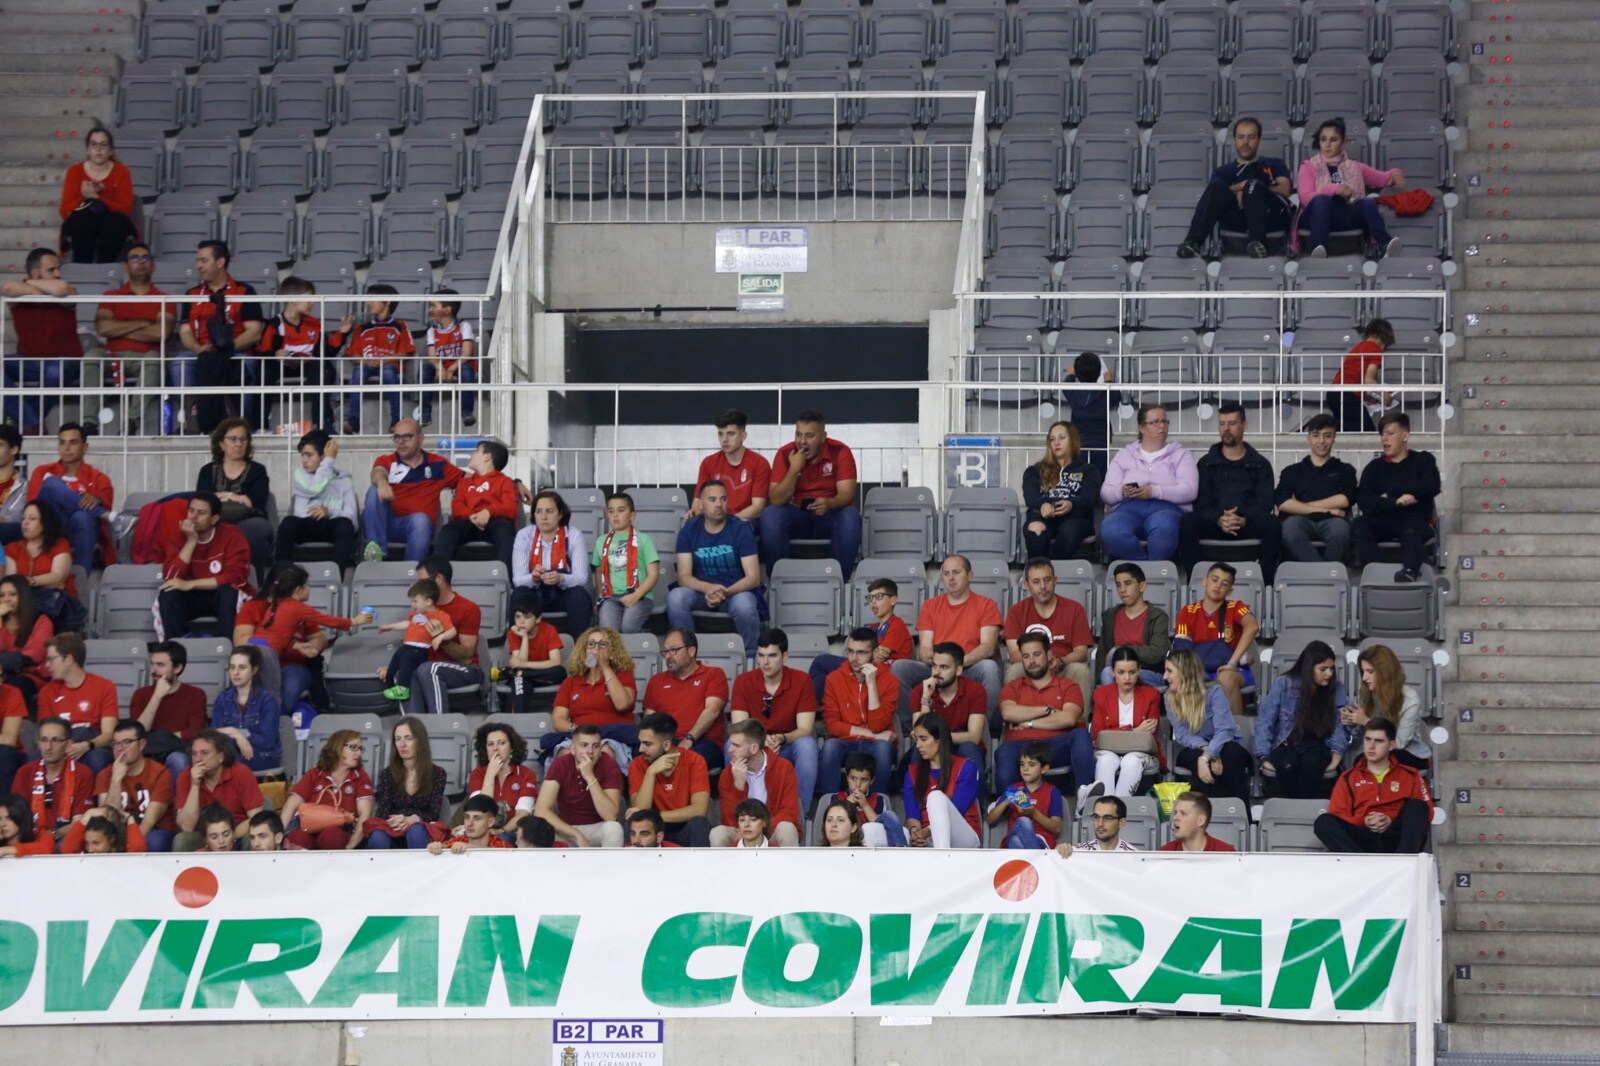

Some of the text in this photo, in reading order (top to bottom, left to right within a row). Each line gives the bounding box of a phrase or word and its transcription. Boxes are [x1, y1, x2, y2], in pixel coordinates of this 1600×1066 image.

[1473, 43, 1482, 54] 6
[1470, 175, 1479, 186] 4
[759, 231, 791, 242] PAR
[742, 278, 779, 288] SALIDA
[960, 452, 986, 485] B
[1463, 558, 1471, 569] 6
[1462, 632, 1471, 643] 5
[1462, 710, 1471, 721] 4
[1459, 791, 1468, 801] 3
[1459, 876, 1468, 887] 2
[1460, 967, 1467, 978] 1
[560, 1025, 643, 1038] B2 PAR
[584, 1050, 656, 1059] AYUNTAMIENTO
